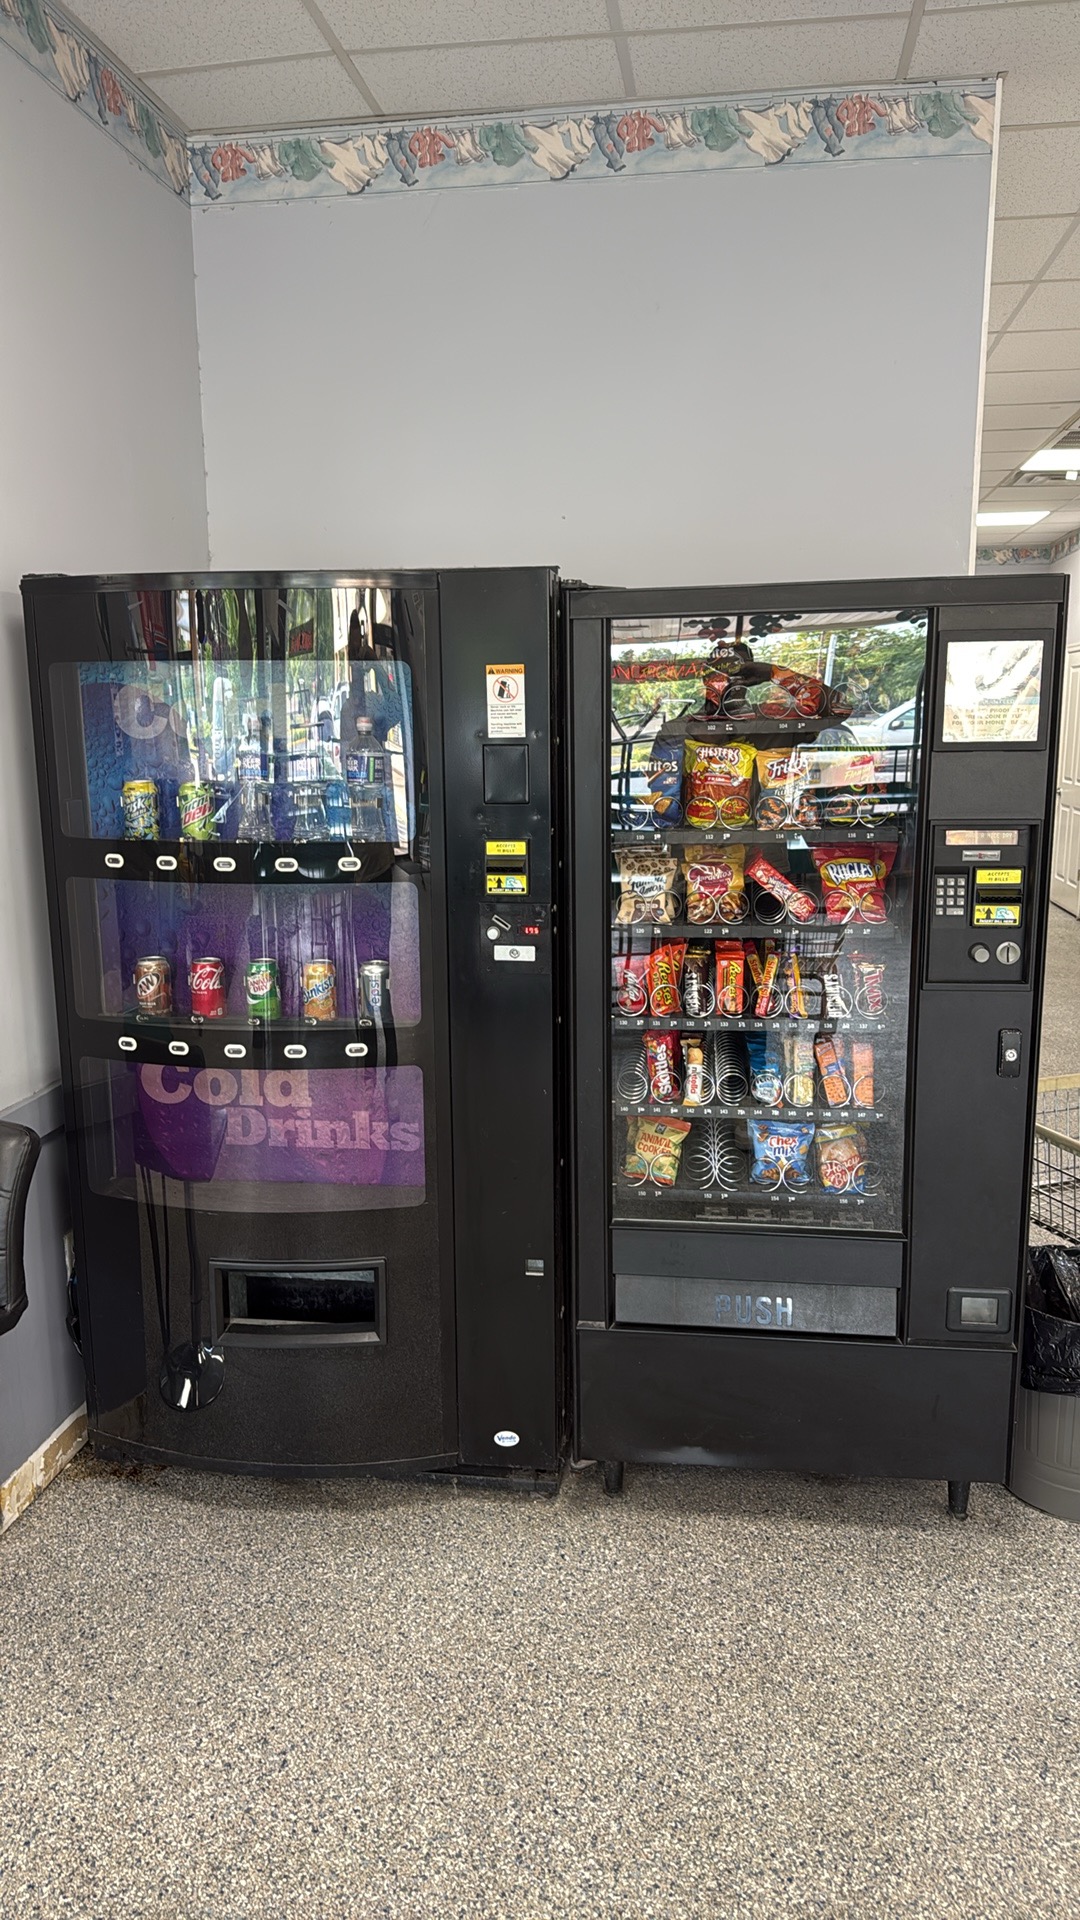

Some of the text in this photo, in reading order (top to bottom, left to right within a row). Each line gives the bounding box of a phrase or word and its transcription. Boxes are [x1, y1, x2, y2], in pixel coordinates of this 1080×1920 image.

[710, 647, 735, 658] itos
[630, 760, 679, 772] Doritos
[766, 756, 808, 781] Fritos
[826, 862, 874, 886] BUGLES
[370, 973, 382, 1005] epsi
[761, 960, 776, 996] Starbust
[863, 968, 883, 1012] TWIX
[654, 1044, 672, 1095] Skittles
[690, 1066, 699, 1095] nutella
[140, 1063, 313, 1108] Cold
[225, 1106, 421, 1151] Drinks
[768, 1135, 797, 1147] Chex
[773, 1144, 797, 1156] mix
[830, 1172, 849, 1189] Bu
[714, 1294, 793, 1326] PUSH
